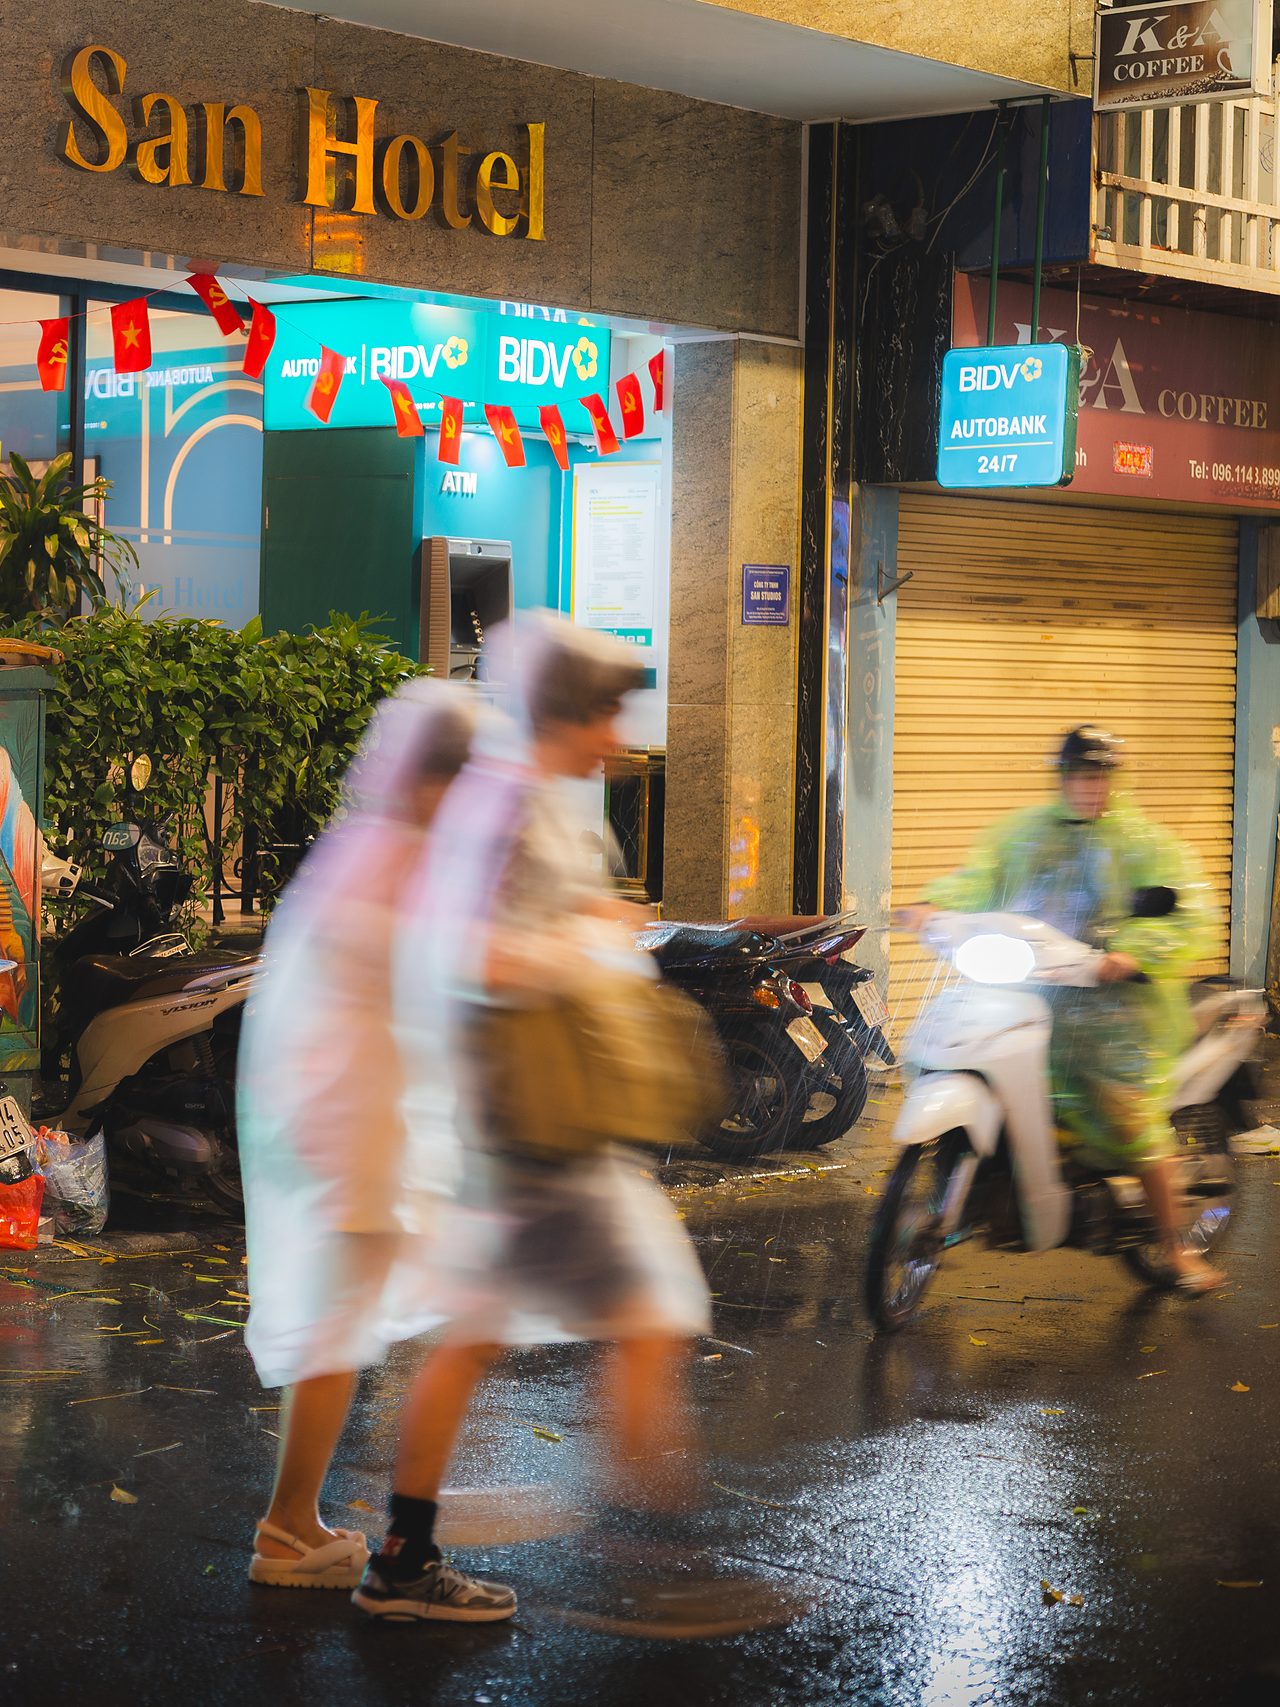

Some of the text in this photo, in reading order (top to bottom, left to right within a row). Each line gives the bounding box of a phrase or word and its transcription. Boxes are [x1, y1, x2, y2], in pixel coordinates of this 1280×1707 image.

[1113, 54, 1204, 81] COFFEE
[57, 44, 547, 241] San Hotel
[370, 344, 444, 380] BIDV
[498, 335, 575, 389] BIDV
[958, 361, 1023, 393] BIDV
[1157, 388, 1269, 430] COFFEE
[950, 415, 1048, 440] AUTOBANK
[977, 454, 1019, 475] 24/7
[1188, 459, 1209, 480] Tel:
[442, 470, 478, 495] ATM
